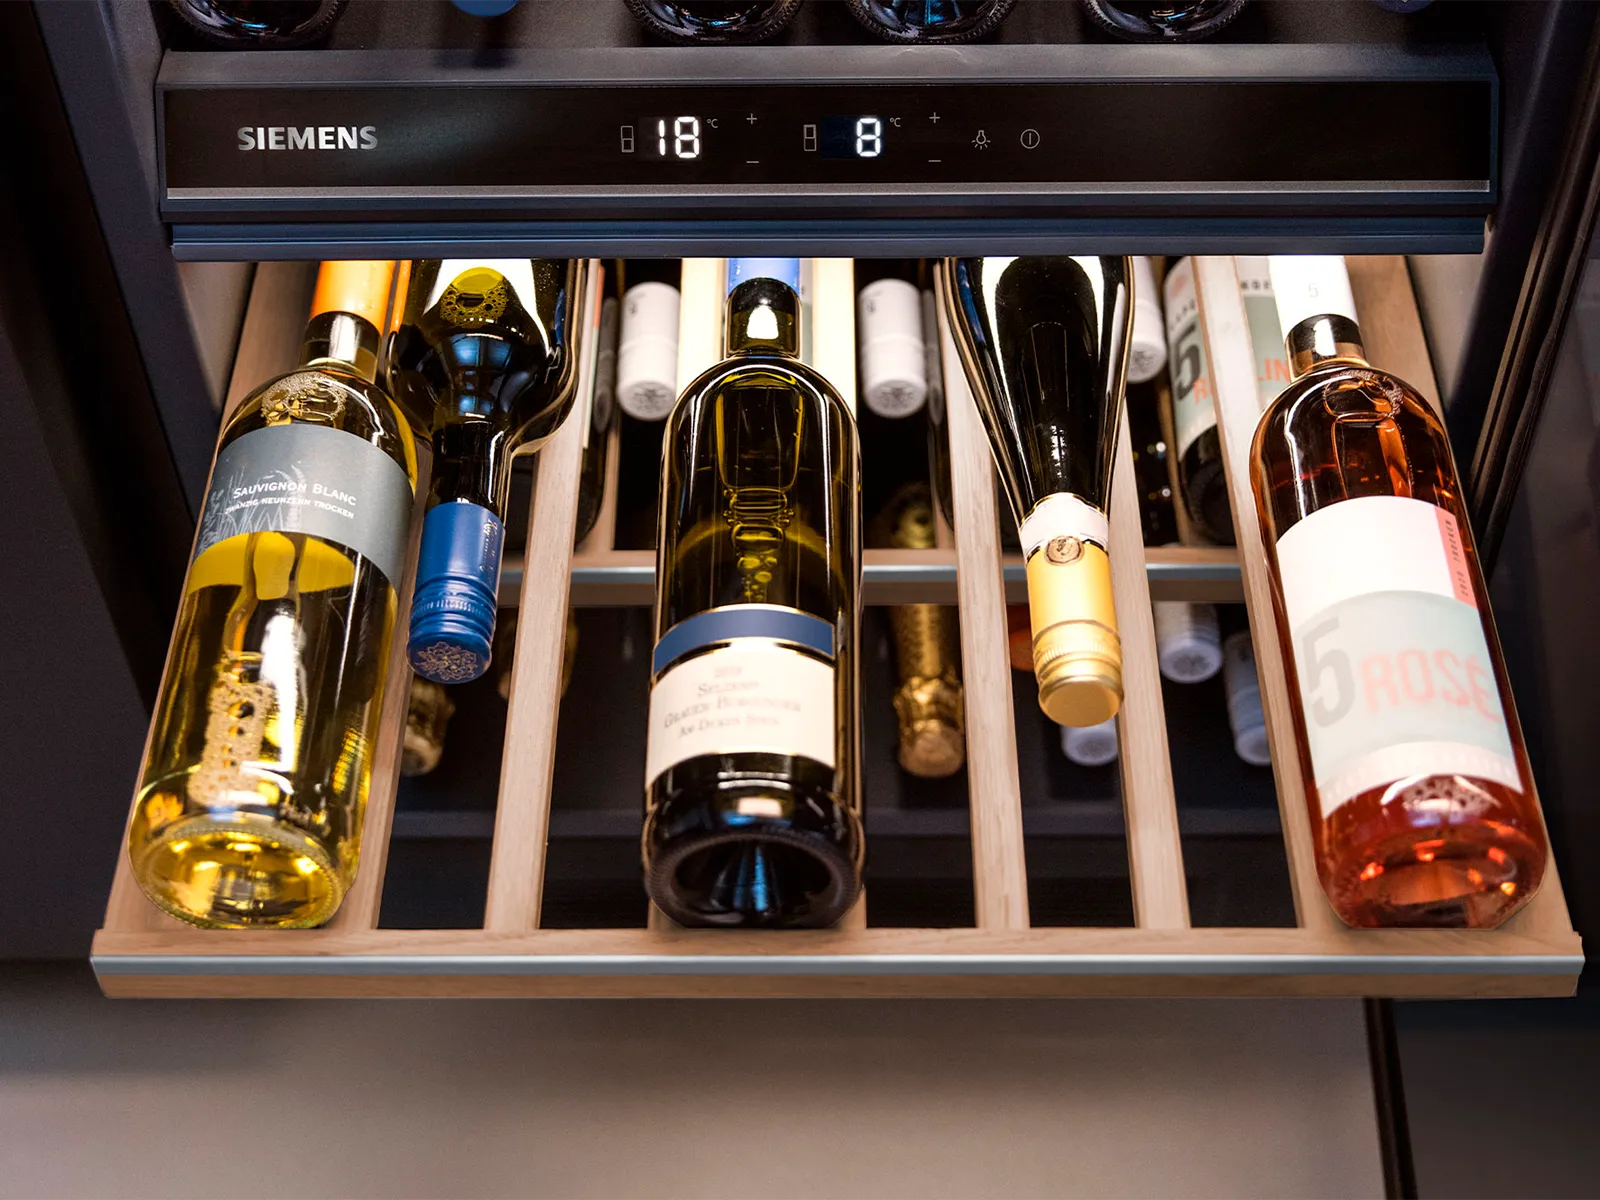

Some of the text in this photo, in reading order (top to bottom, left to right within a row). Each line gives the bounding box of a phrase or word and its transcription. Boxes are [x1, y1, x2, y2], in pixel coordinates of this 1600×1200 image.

[237, 125, 378, 151] SIEMENS
[658, 115, 702, 159] 18
[856, 117, 882, 158] 8
[1308, 281, 1319, 298] 5
[232, 482, 357, 506] SAUVIGNON BLANC
[314, 500, 354, 519] TROCKEN
[1301, 615, 1356, 728] 5
